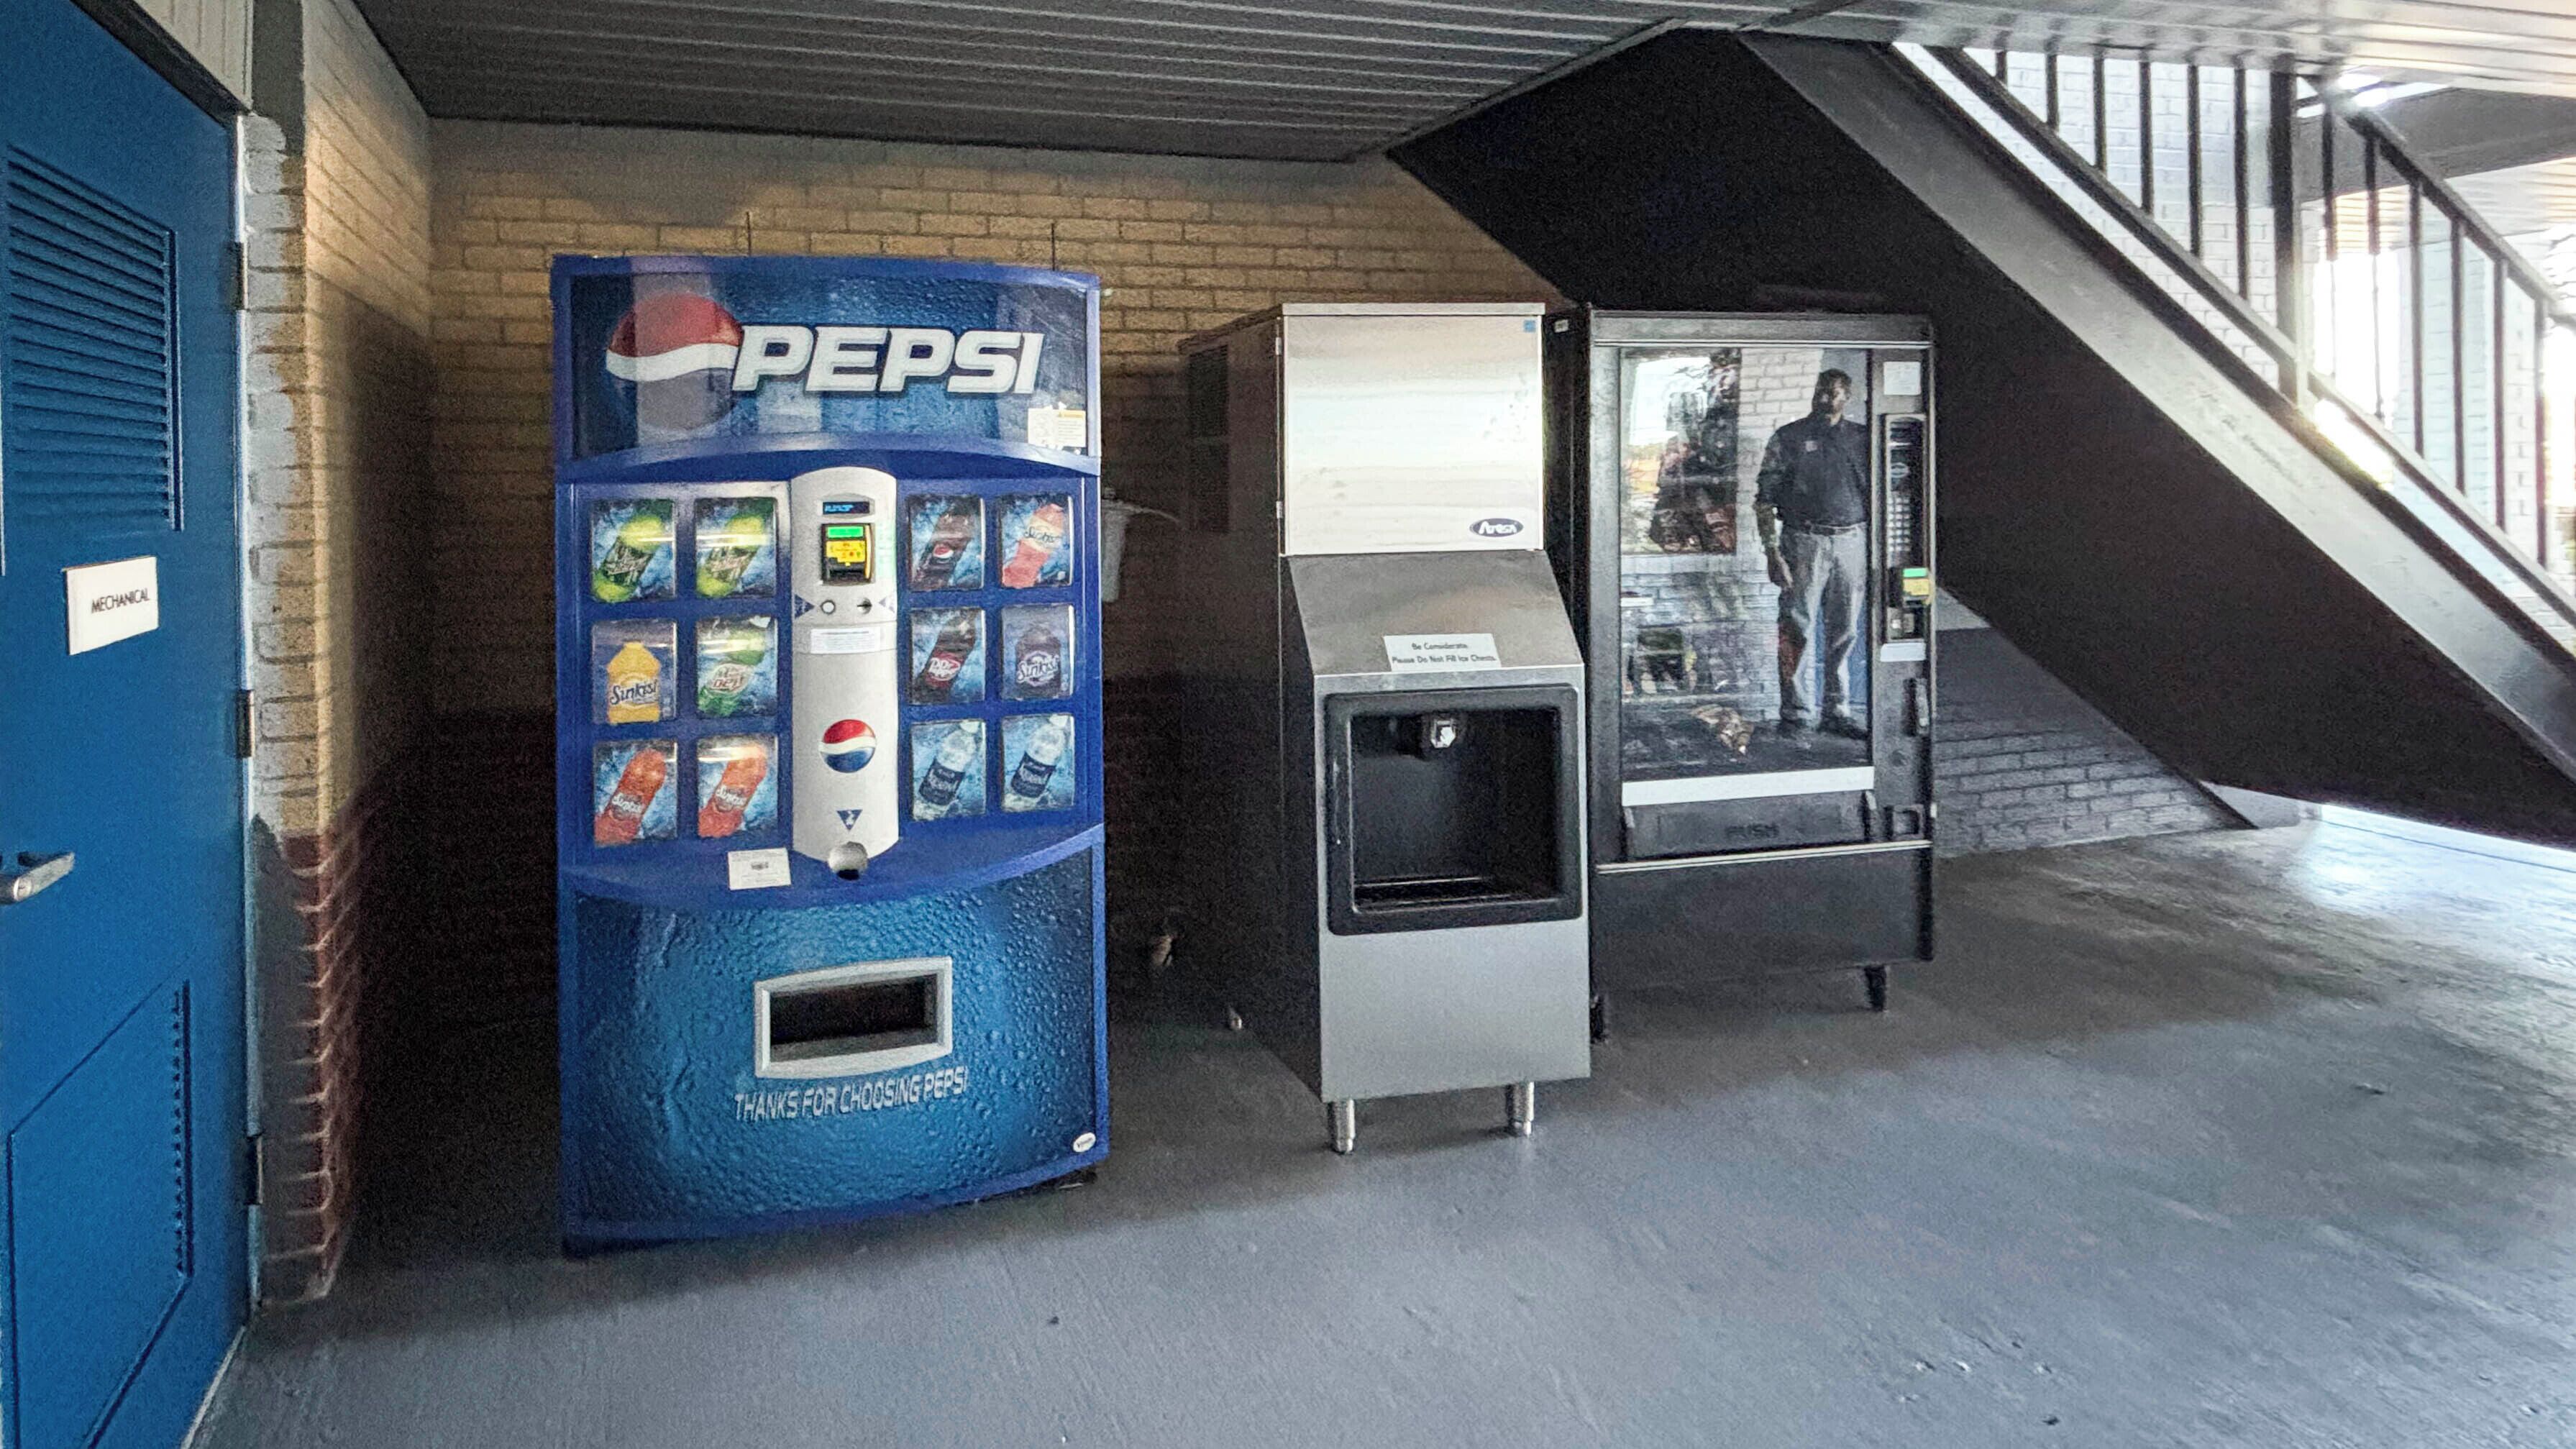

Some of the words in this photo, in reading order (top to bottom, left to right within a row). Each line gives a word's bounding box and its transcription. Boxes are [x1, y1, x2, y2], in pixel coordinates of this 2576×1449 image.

[732, 324, 1045, 395] PEPSI
[91, 588, 150, 614] MECHANICAL
[1392, 655, 1415, 664] Please
[734, 1089, 798, 1123] THANKS
[802, 1086, 837, 1117] FOR
[839, 1074, 921, 1113] CHOOSING
[923, 1065, 968, 1102] PEPSI
